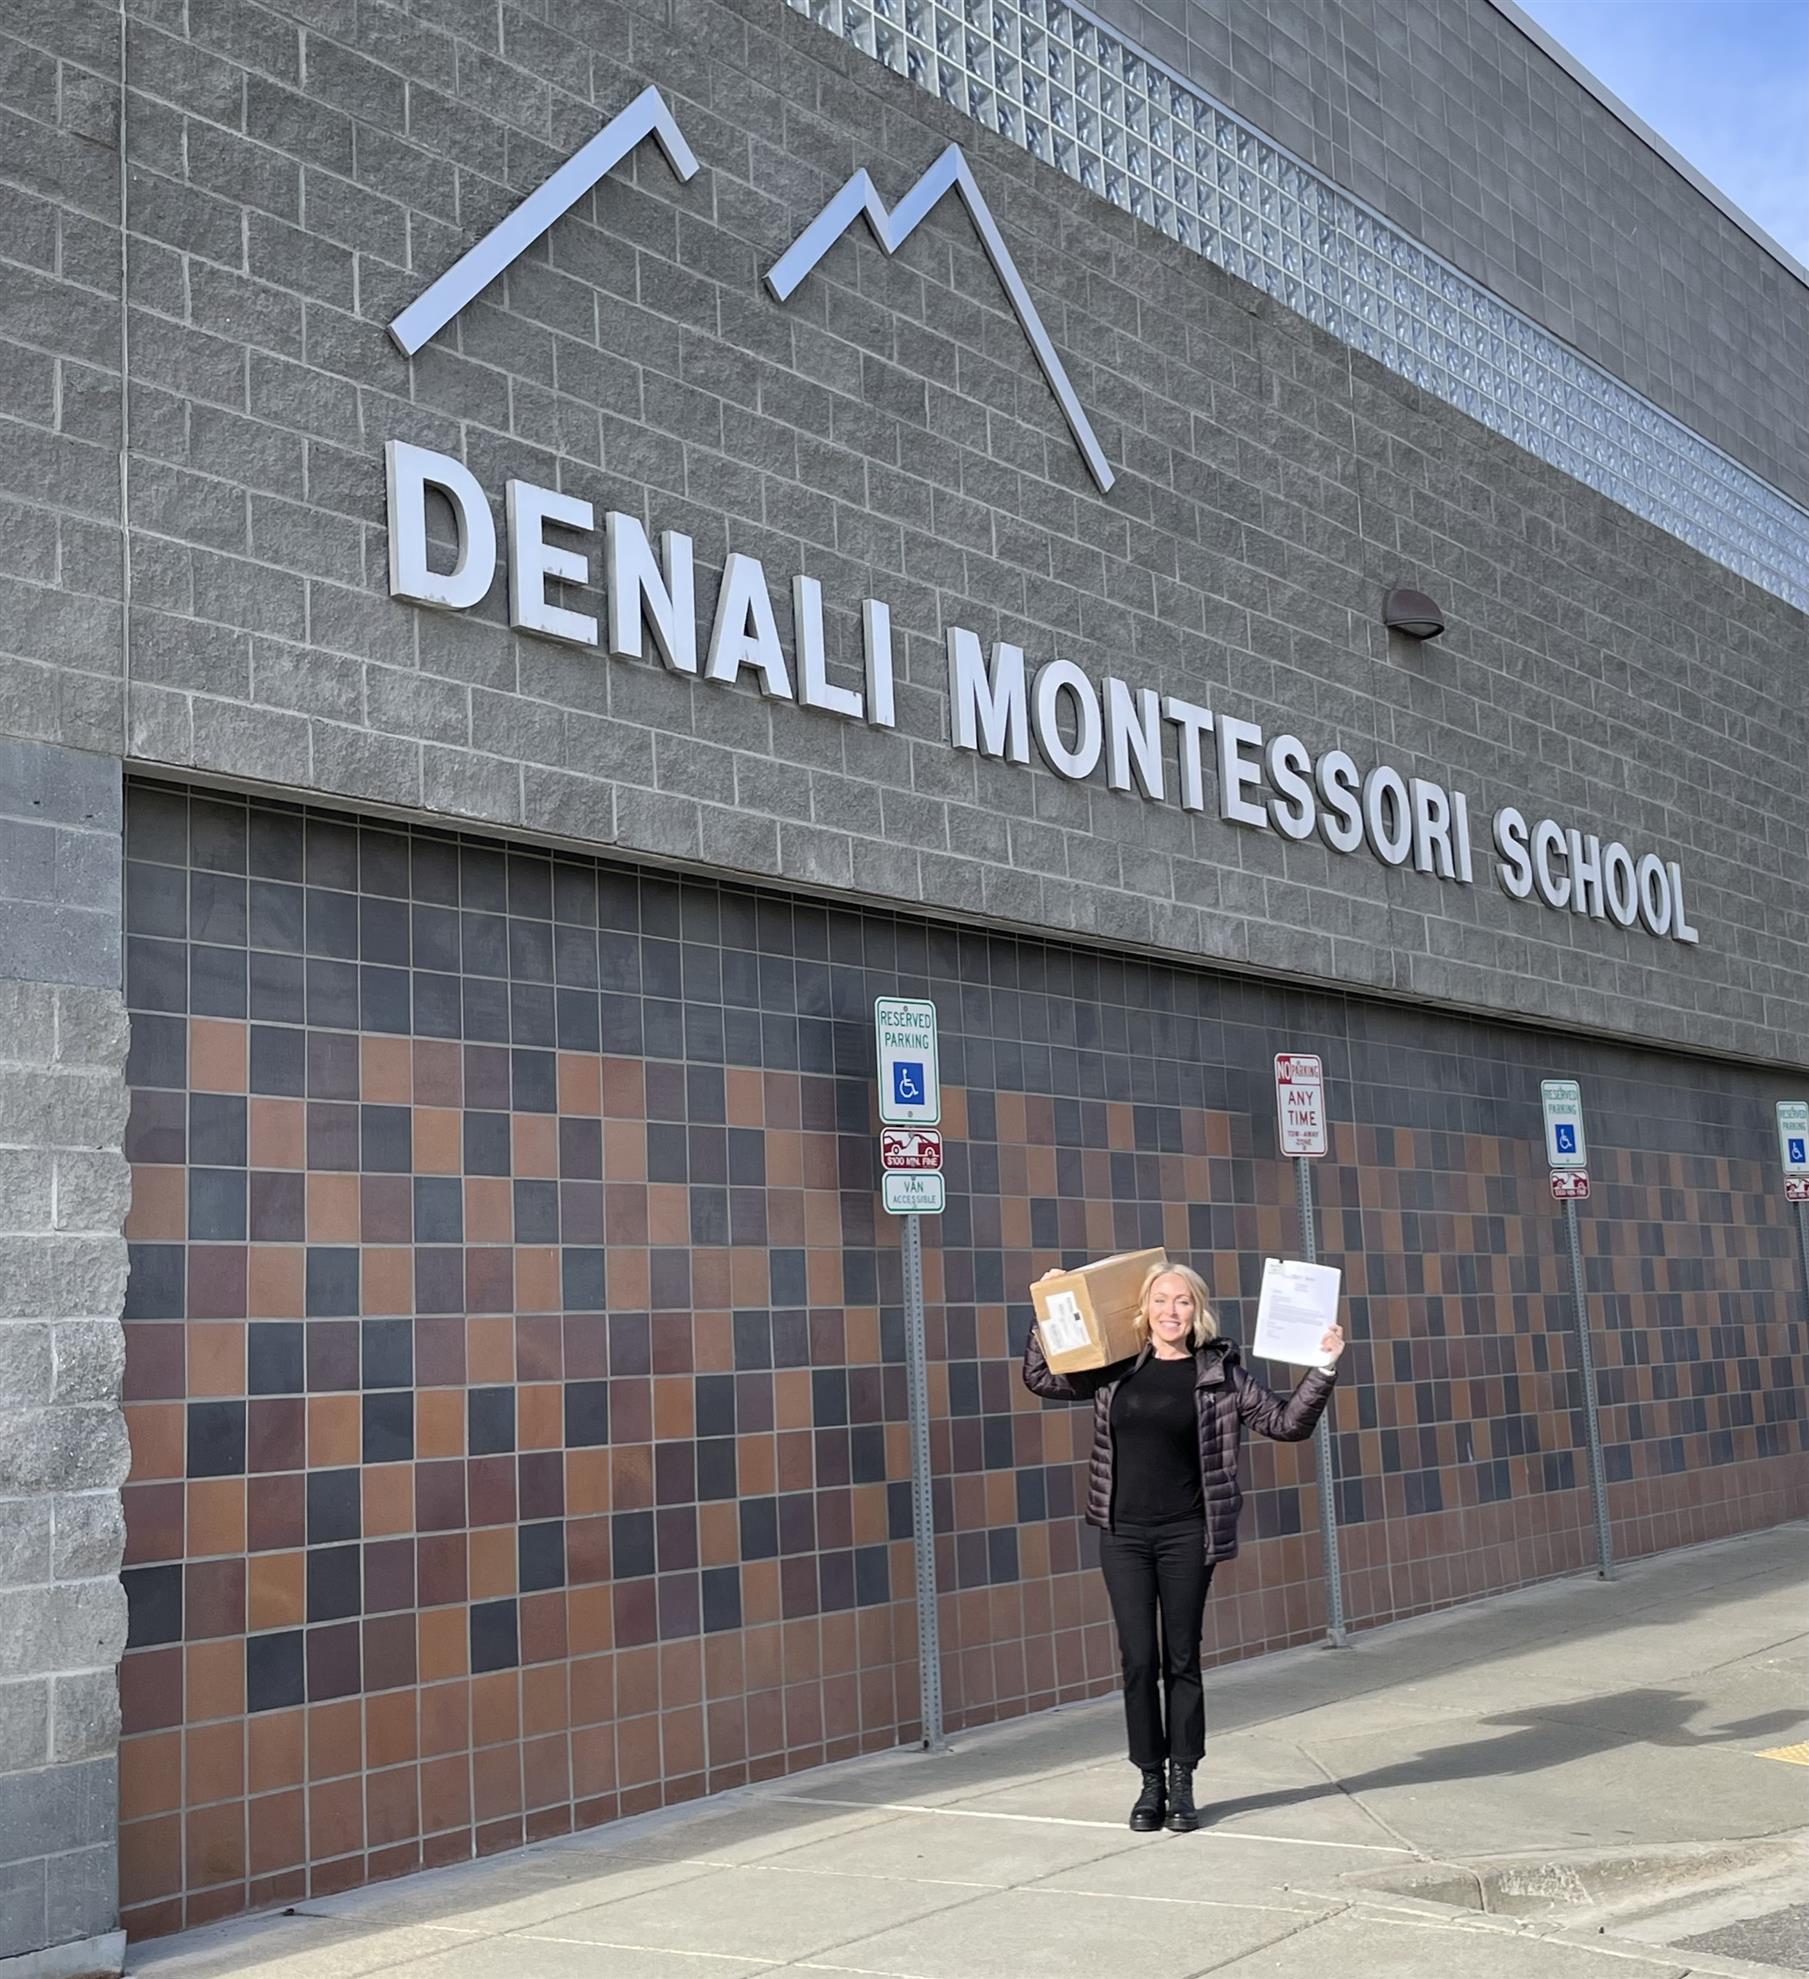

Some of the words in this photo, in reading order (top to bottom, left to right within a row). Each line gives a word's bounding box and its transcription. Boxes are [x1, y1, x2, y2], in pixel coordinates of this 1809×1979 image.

[385, 439, 895, 728] DENALI
[946, 626, 1473, 884] MONTESSORI
[1494, 807, 1699, 944] SCHOOL
[880, 1010, 931, 1028] RESERVED
[885, 1032, 929, 1049] PARKING
[1277, 1060, 1291, 1080] NO
[1291, 1064, 1320, 1077] PARKING
[1288, 1091, 1314, 1106] ANY
[1288, 1111, 1317, 1126] TIME
[886, 1156, 905, 1166] $100
[922, 1157, 938, 1166] FINE
[903, 1181, 924, 1193] VAN
[892, 1195, 937, 1204] ACCESSIBLE
